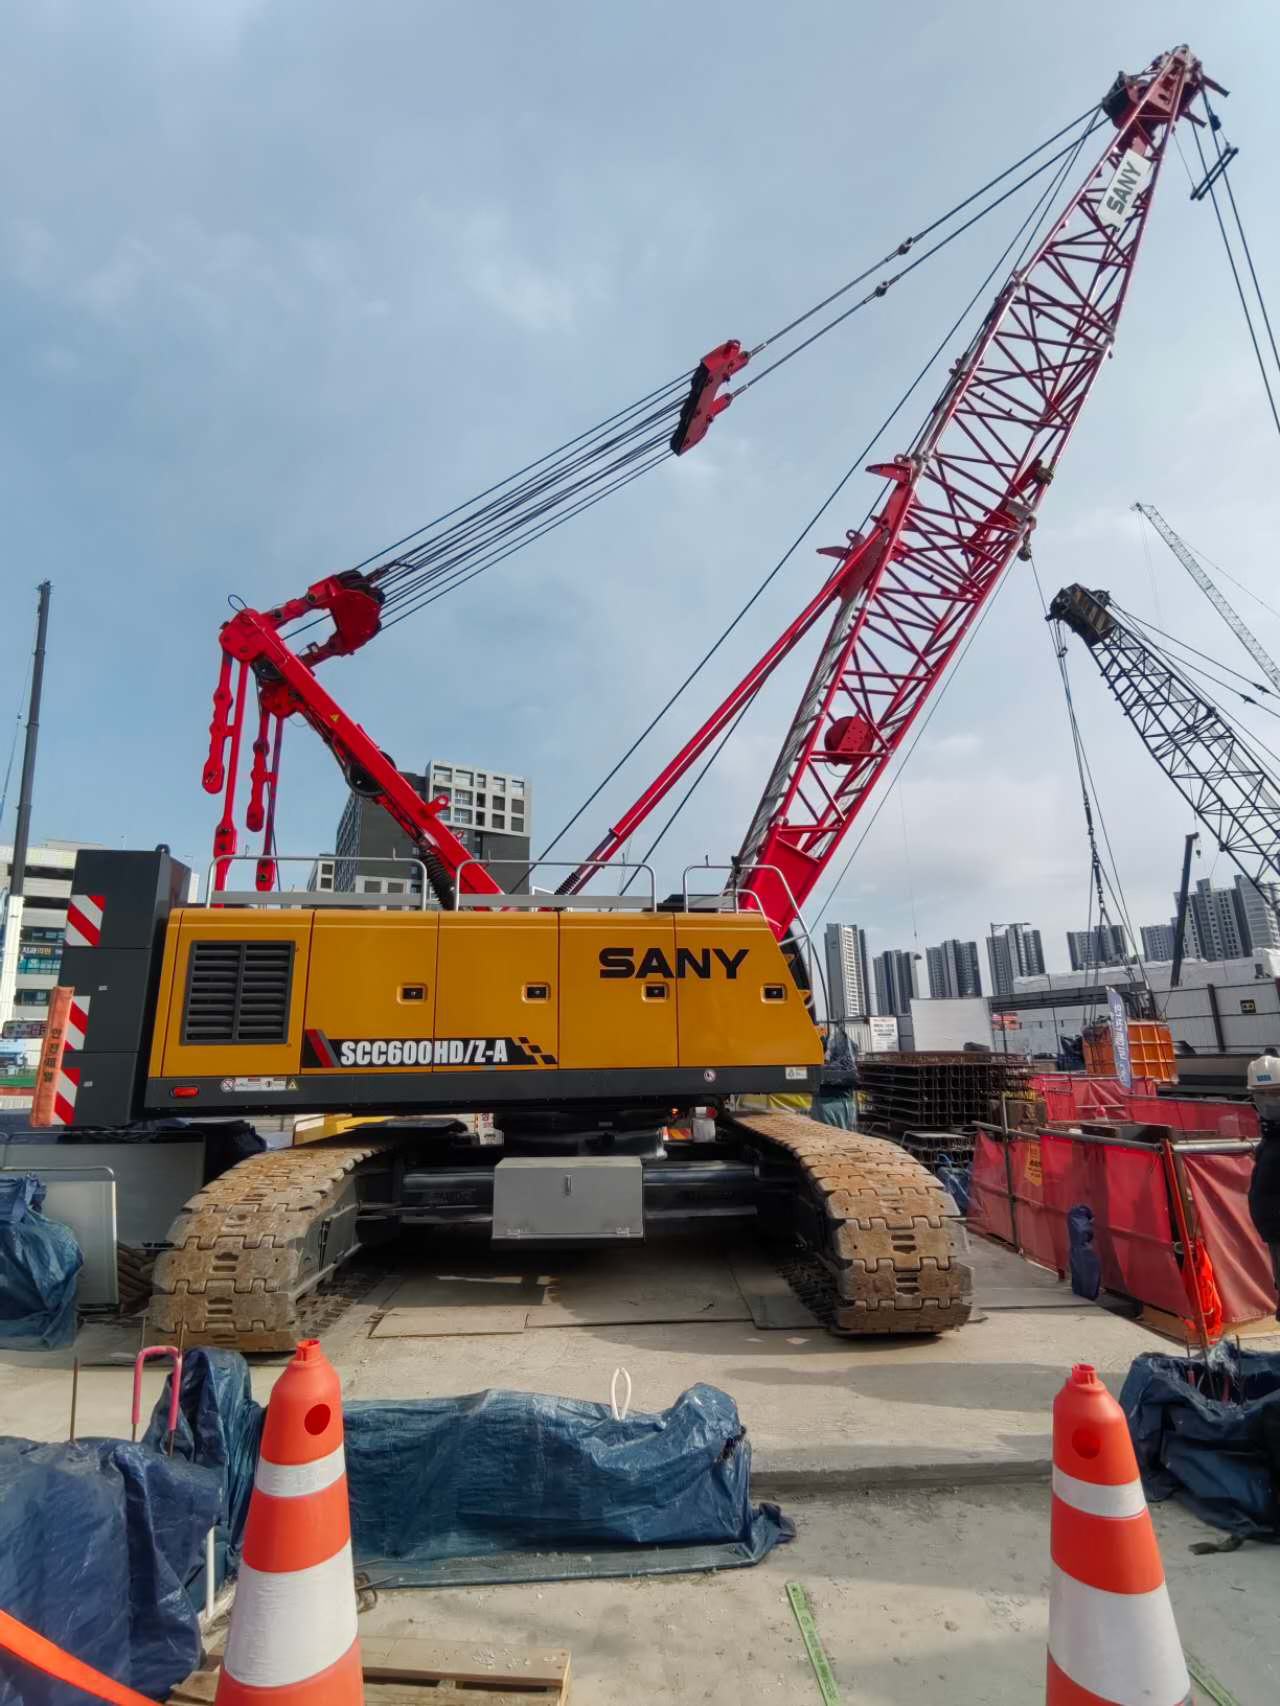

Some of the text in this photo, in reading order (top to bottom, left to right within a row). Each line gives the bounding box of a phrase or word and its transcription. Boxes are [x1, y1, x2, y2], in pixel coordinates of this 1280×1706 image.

[1106, 161, 1141, 215] SANY
[599, 947, 749, 979] SANY
[340, 1040, 508, 1065] SCC600HD/Z-A
